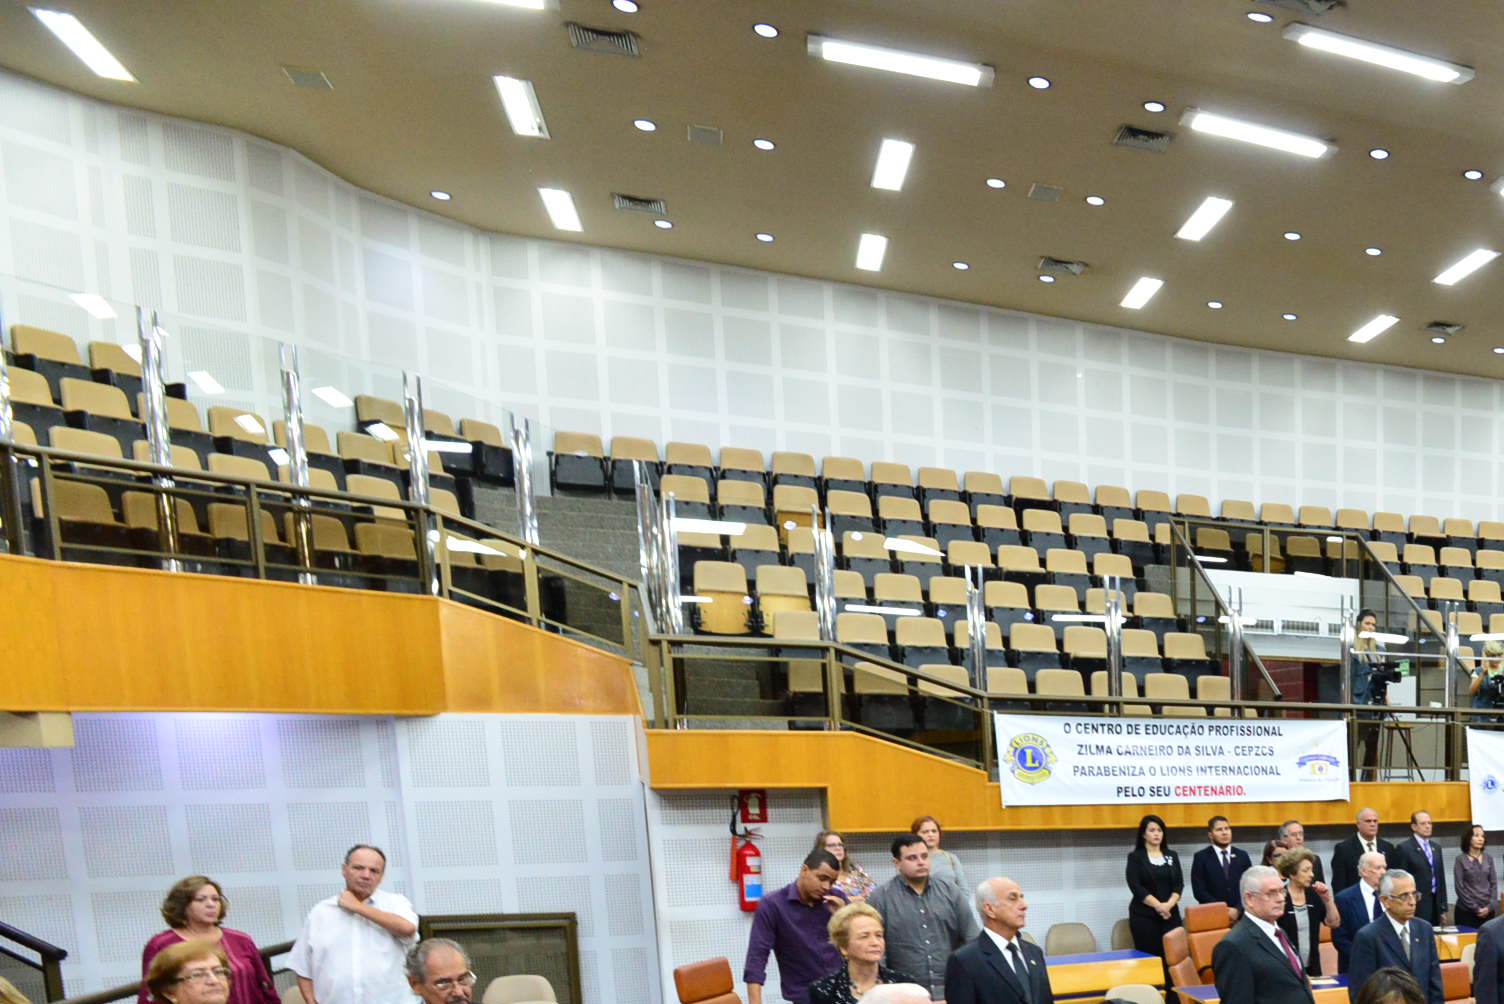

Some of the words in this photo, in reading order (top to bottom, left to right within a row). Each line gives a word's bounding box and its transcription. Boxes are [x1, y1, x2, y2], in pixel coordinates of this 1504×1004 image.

[1063, 722, 1072, 734] O
[1075, 722, 1123, 735] CENTRO
[1126, 723, 1141, 736] DE
[1144, 721, 1205, 738] EDUCAÇÃO
[1208, 724, 1283, 737] PROFISSIONAL
[1013, 735, 1046, 748] LIONS
[1077, 743, 1113, 756] ZILMA
[1116, 744, 1174, 757] CARNEIRO
[1177, 745, 1192, 756] DA
[1194, 745, 1225, 757] SILVA
[1023, 749, 1040, 767] L
[1072, 765, 1146, 777] PARABENIZA
[1148, 765, 1157, 777] O
[1160, 765, 1193, 777] LIONS
[1196, 765, 1282, 777] INTERNACIONAL
[1116, 786, 1146, 798] PELO
[1149, 785, 1171, 798] SEU
